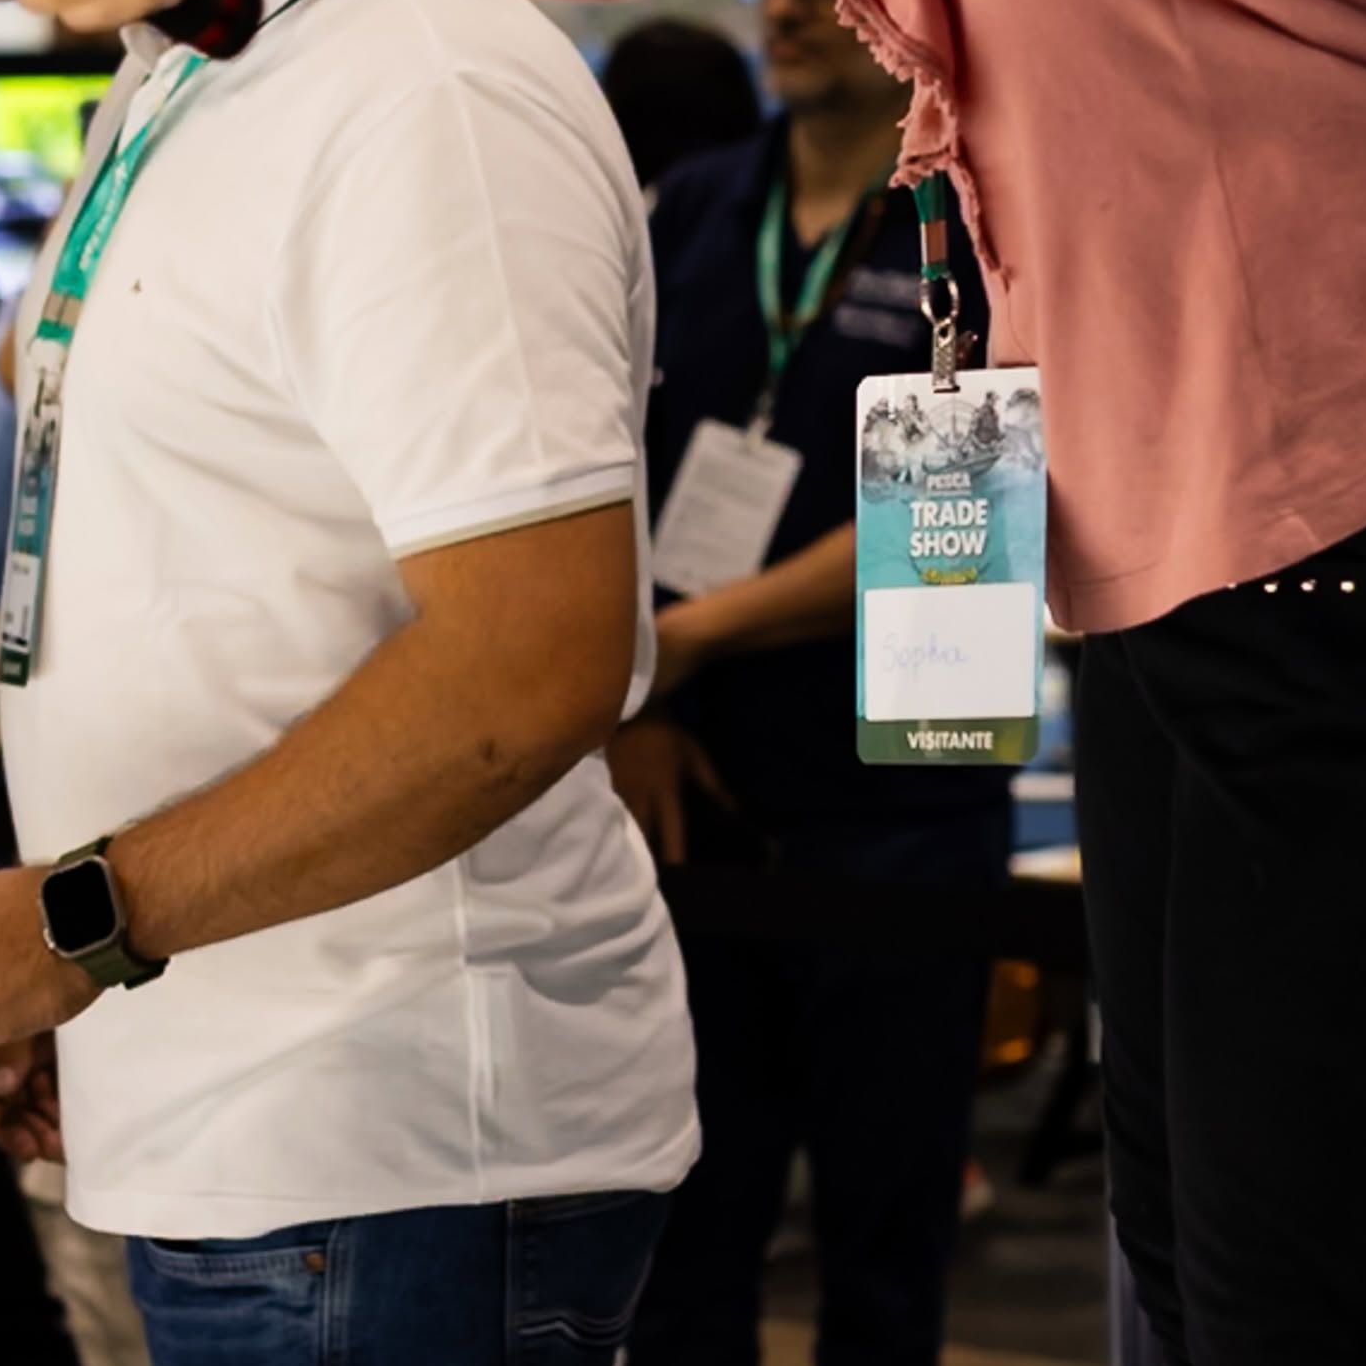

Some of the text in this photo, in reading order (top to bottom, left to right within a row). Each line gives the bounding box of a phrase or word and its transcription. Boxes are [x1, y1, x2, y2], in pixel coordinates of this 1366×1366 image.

[926, 473, 971, 489] PESCA
[910, 499, 988, 526] TRADE
[910, 530, 987, 557] SHOW
[906, 730, 994, 750] VISITANTE
